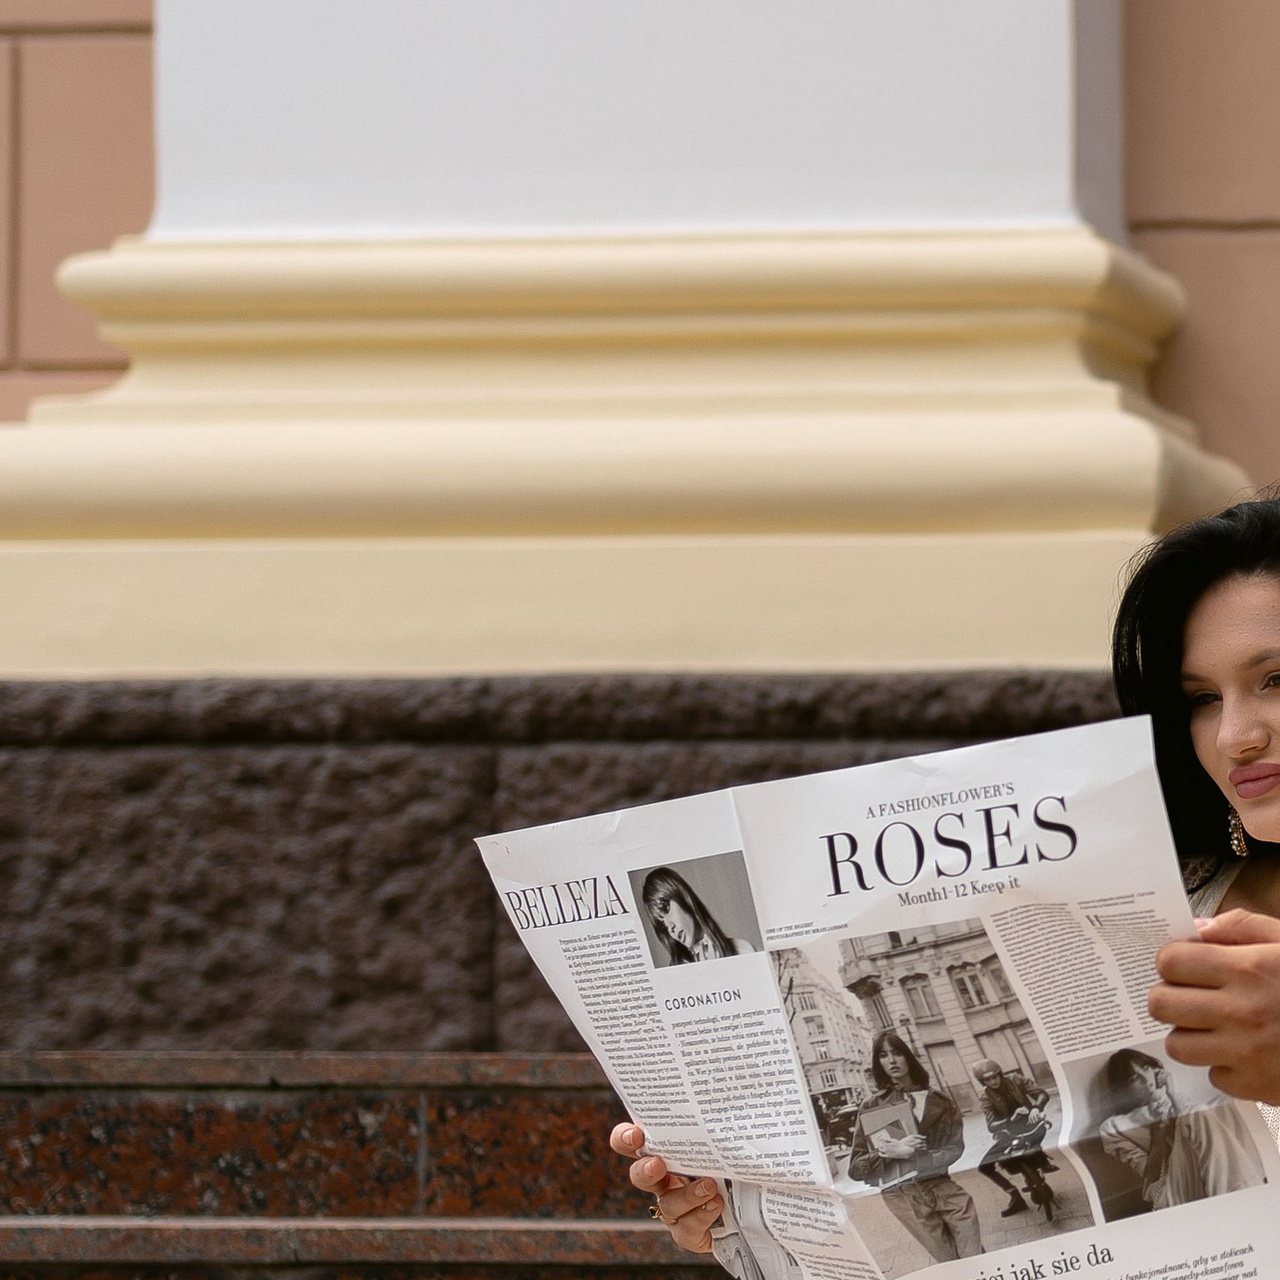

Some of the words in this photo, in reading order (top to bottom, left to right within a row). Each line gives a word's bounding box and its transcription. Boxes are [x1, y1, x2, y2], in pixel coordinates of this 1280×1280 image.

[866, 806, 876, 819] A
[878, 782, 1015, 817] FASHIONFLOWER'S
[818, 795, 1078, 897] ROSES
[970, 878, 1005, 896] Keep
[1008, 875, 1021, 889] it
[505, 874, 631, 931] BELLEZA
[664, 988, 742, 1011] CORONATION
[1052, 1251, 1082, 1276] sie
[1086, 1244, 1114, 1268] da
[1193, 1256, 1209, 1269] gdy
[1220, 1244, 1254, 1260] stolicach
[1242, 1269, 1258, 1279] nad
